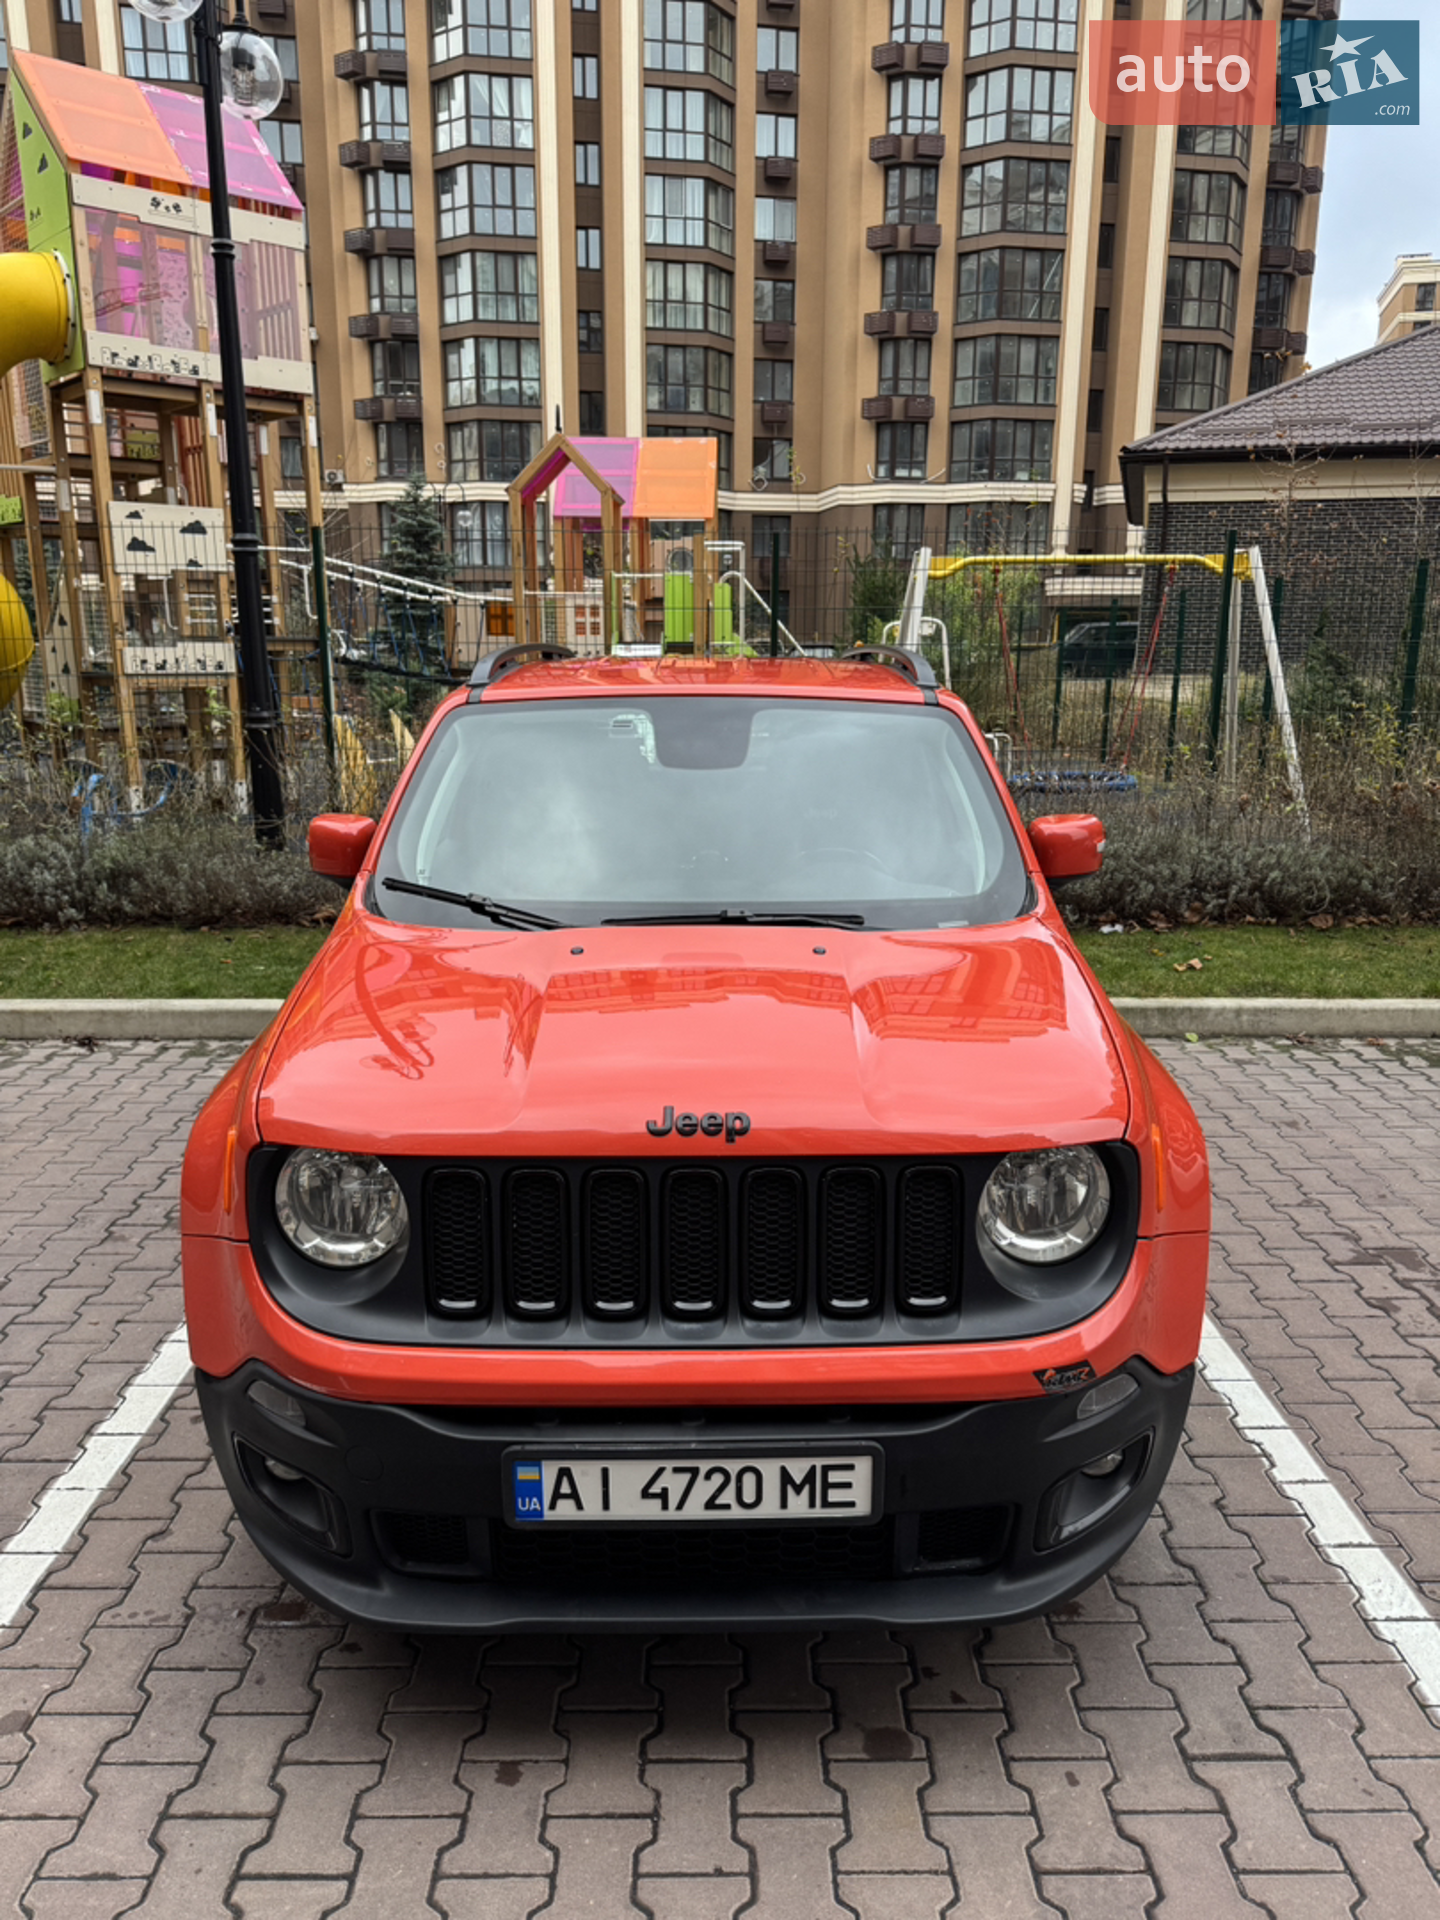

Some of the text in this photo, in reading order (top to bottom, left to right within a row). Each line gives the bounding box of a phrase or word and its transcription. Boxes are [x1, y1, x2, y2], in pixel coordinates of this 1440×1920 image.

[646, 1105, 751, 1145] Jeep
[518, 1496, 541, 1512] UA
[548, 1463, 856, 1511] AI 4720 ME
